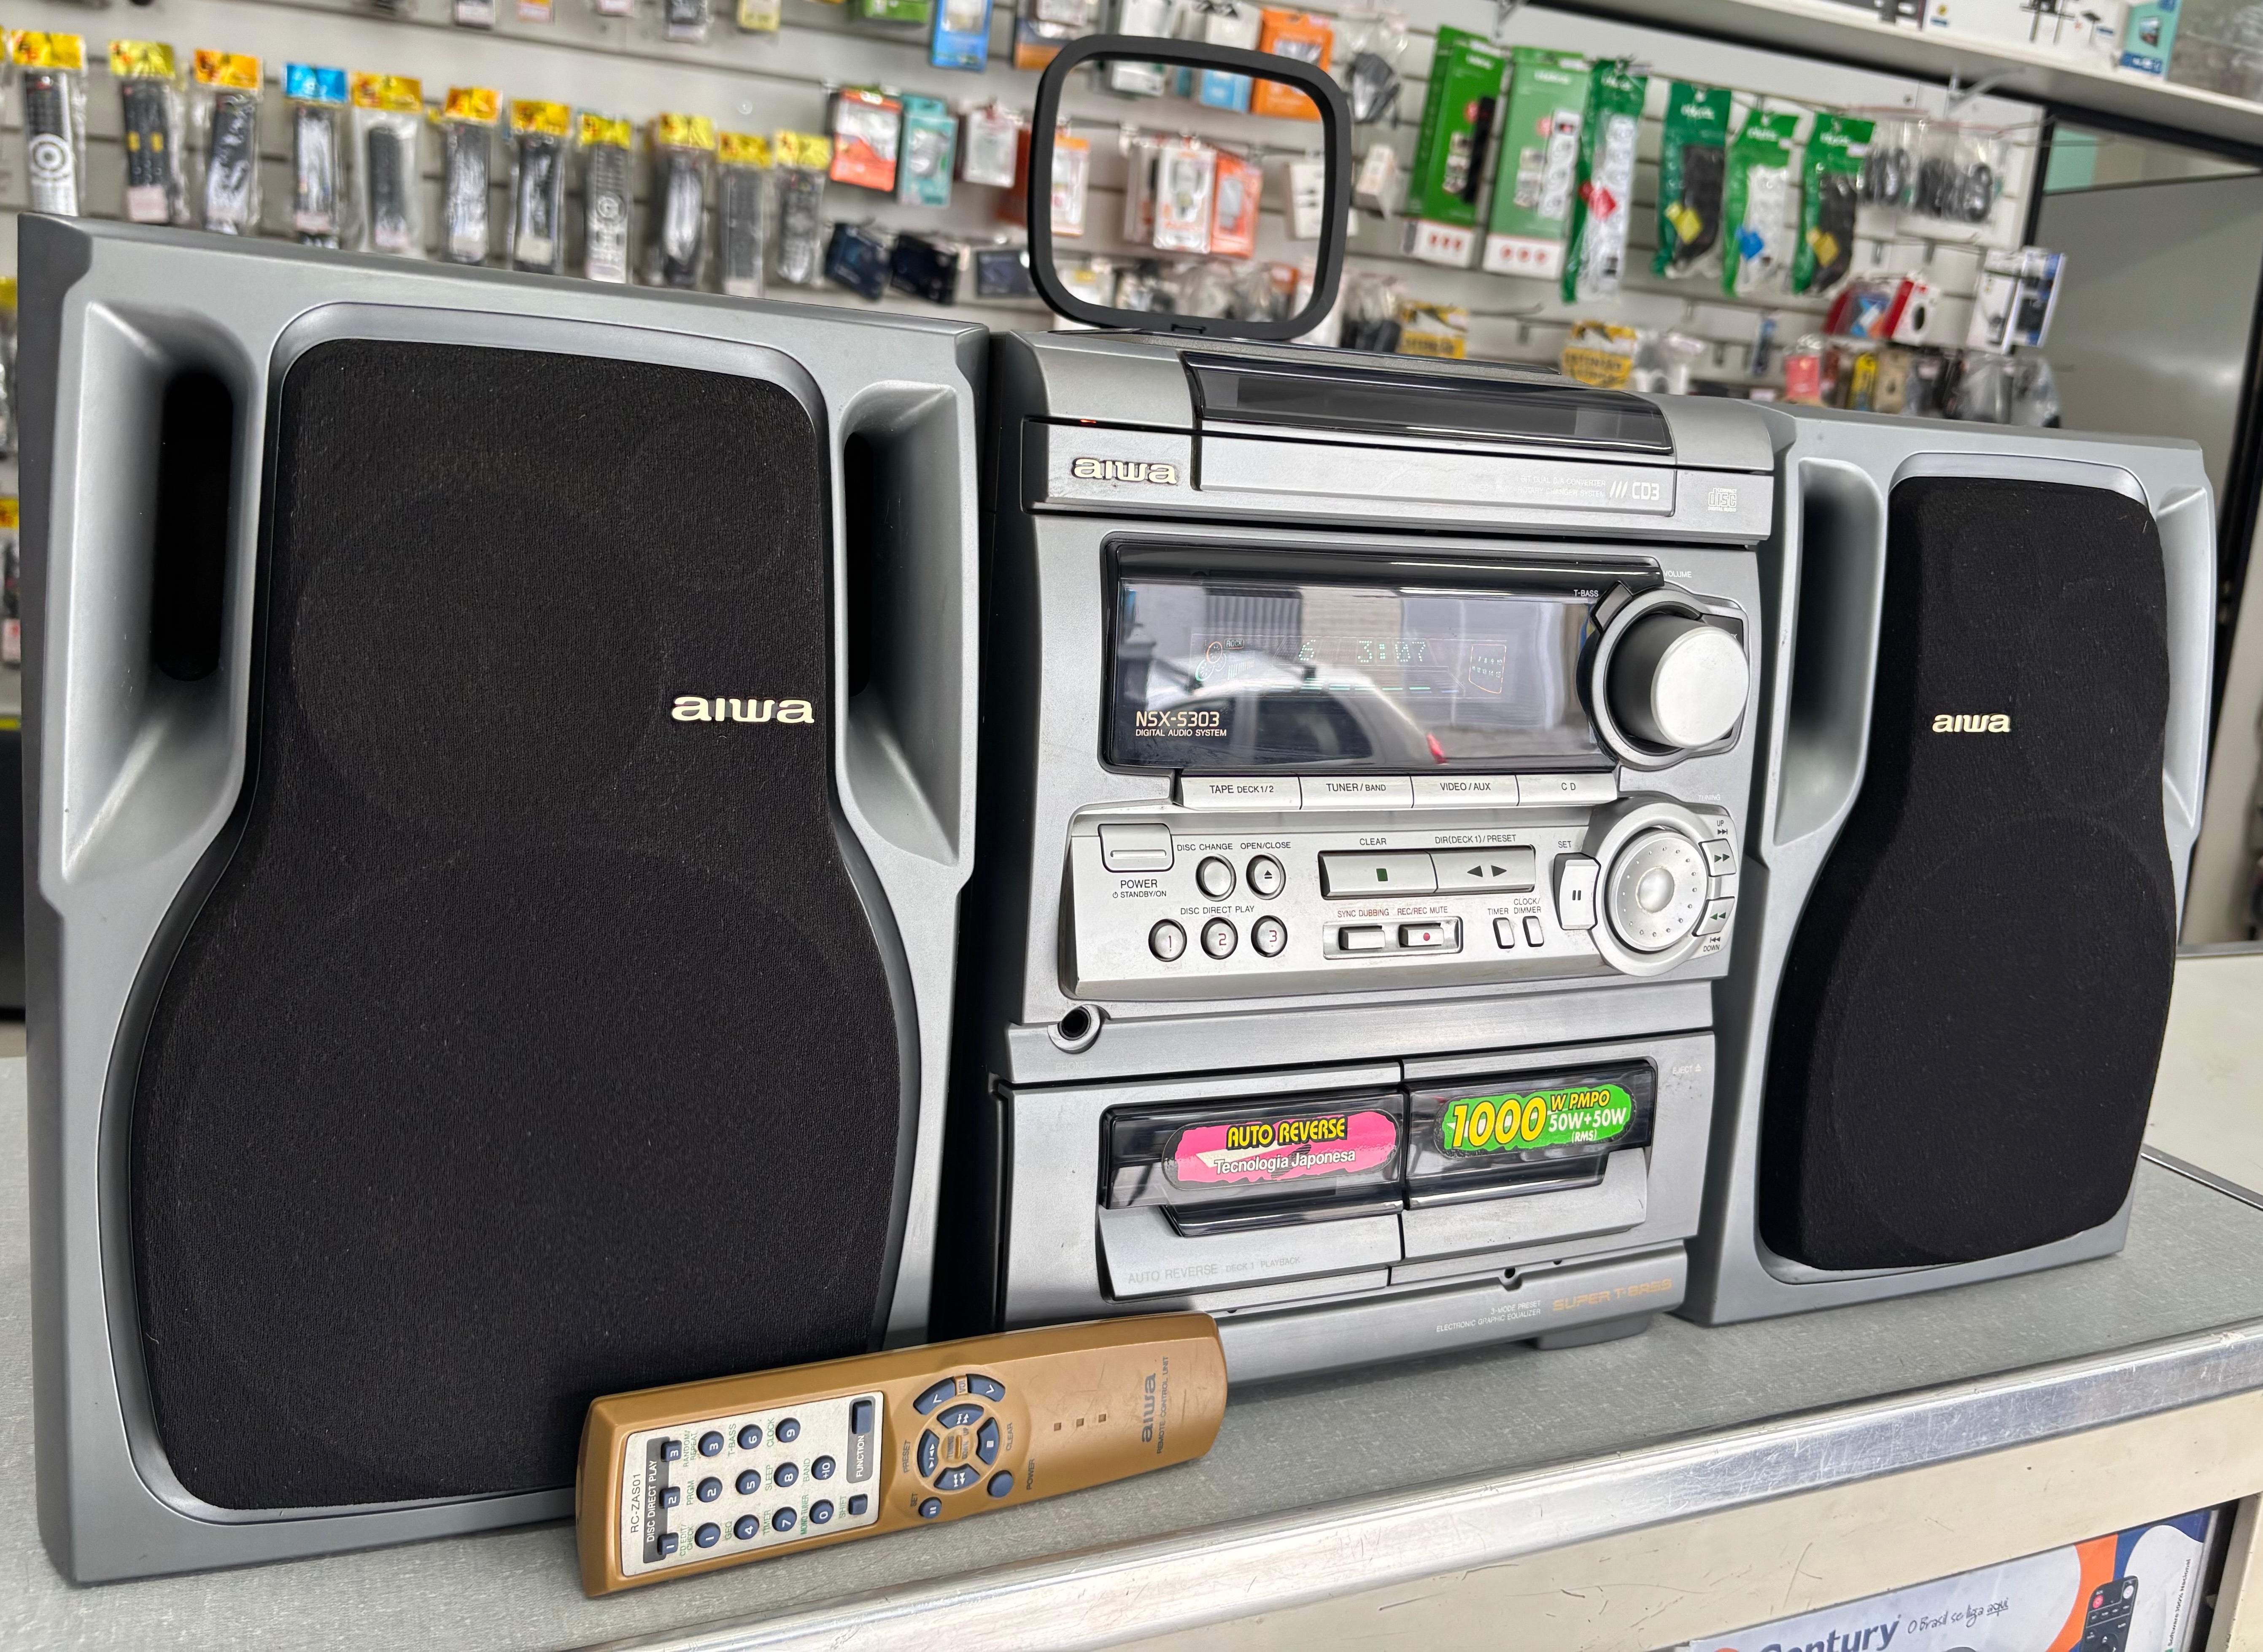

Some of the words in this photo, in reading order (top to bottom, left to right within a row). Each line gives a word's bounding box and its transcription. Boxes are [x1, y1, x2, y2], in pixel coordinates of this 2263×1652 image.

[1073, 458, 1177, 484] aiwa
[1566, 478, 1606, 487] CONVERTER
[1632, 482, 1660, 501] CD3
[1663, 570, 1692, 578] VOLUME
[1573, 589, 1599, 597] T-BASS
[1226, 639, 1242, 648] ROCK
[672, 696, 815, 723] aiwa
[1136, 710, 1220, 727] NSX-S303
[1932, 714, 2011, 733] aiwa
[1209, 785, 1235, 794] TAPE
[1199, 842, 1233, 851] CHANGE
[1240, 841, 1291, 850] OPEN/CLOSE
[1359, 837, 1387, 846] CLEAR
[1558, 840, 1572, 848] SET
[1120, 879, 1157, 889] POWER
[1120, 890, 1167, 898] STANDBY/ON
[1180, 907, 1200, 915] DISC
[1203, 906, 1232, 914] DIRECT
[1235, 905, 1255, 913] PLAY
[1337, 909, 1356, 918] SYNC
[1358, 908, 1389, 917] DUBBING
[1397, 907, 1427, 915] REC/REC
[1430, 906, 1448, 914] MUTE
[1513, 906, 1542, 914] DIMMER
[1218, 932, 1227, 946] 2
[1268, 930, 1278, 942] 3
[1703, 944, 1720, 952] DOWN
[1672, 1065, 1693, 1074] EJECT
[1550, 1095, 1566, 1111] W
[1569, 1090, 1610, 1109] PMPO
[1451, 1097, 1547, 1148] 1000
[1548, 1107, 1627, 1132] 50W+50W
[1227, 1123, 1274, 1147] AUTO
[1278, 1117, 1346, 1143] REVERSE
[1571, 1128, 1598, 1143] (RMS)
[1214, 1154, 1289, 1175] Tecnologia
[1291, 1150, 1356, 1169] Japonesa
[1128, 1271, 1160, 1284] AUTO
[1165, 1264, 1218, 1279] REVERSE
[1226, 1264, 1248, 1272] DECK
[1260, 1256, 1300, 1269] PLAYBACK
[1491, 1304, 1516, 1315] 3-MODE
[1518, 1300, 1542, 1310] PRESET
[1553, 1289, 1611, 1311] SUPER
[1436, 1320, 1476, 1333] ELECTRONIC
[1478, 1315, 1505, 1325] GRAPHIC
[1507, 1309, 1541, 1320] EQUALIZER
[958, 1379, 966, 1393] VOL
[1160, 1377, 1168, 1417] CONTROL
[1141, 1372, 1156, 1443] aiwa
[728, 1423, 736, 1457] T-BASS
[749, 1435, 758, 1444] 6
[767, 1417, 775, 1447] CLOCK
[786, 1429, 795, 1437] 9
[1157, 1420, 1166, 1454] REMOTE
[709, 1442, 718, 1450] 3
[856, 1435, 865, 1478] FUNCTION
[901, 1439, 911, 1474] PRESET
[649, 1460, 658, 1482] PLAY
[765, 1464, 773, 1491] SLEEP
[784, 1473, 793, 1482] 8
[803, 1458, 811, 1482] BAND
[822, 1462, 831, 1479] +10
[1026, 1458, 1035, 1490] POWER
[686, 1479, 694, 1506] PRGM
[707, 1488, 717, 1497] 2
[746, 1480, 755, 1490] 5
[631, 1474, 641, 1533] RC-ZAS01
[647, 1485, 656, 1518] DIRECT
[668, 1496, 677, 1504] 2
[839, 1495, 847, 1519] SHIFT
[910, 1493, 918, 1507] SET
[763, 1509, 771, 1536] TIMER
[819, 1511, 828, 1519] 0
[725, 1521, 733, 1540] GEQ
[744, 1525, 753, 1535] 4
[782, 1519, 791, 1528] 7
[646, 1522, 655, 1543] DISC
[680, 1543, 686, 1556] CD
[2179, 1559, 2191, 1592] Nacional
[1907, 1620, 1917, 1634] O
[1919, 1611, 1948, 1631] Brasil
[1951, 1612, 1964, 1623] se
[1966, 1604, 1984, 1628] liga
[1986, 1597, 2009, 1617] aqui
